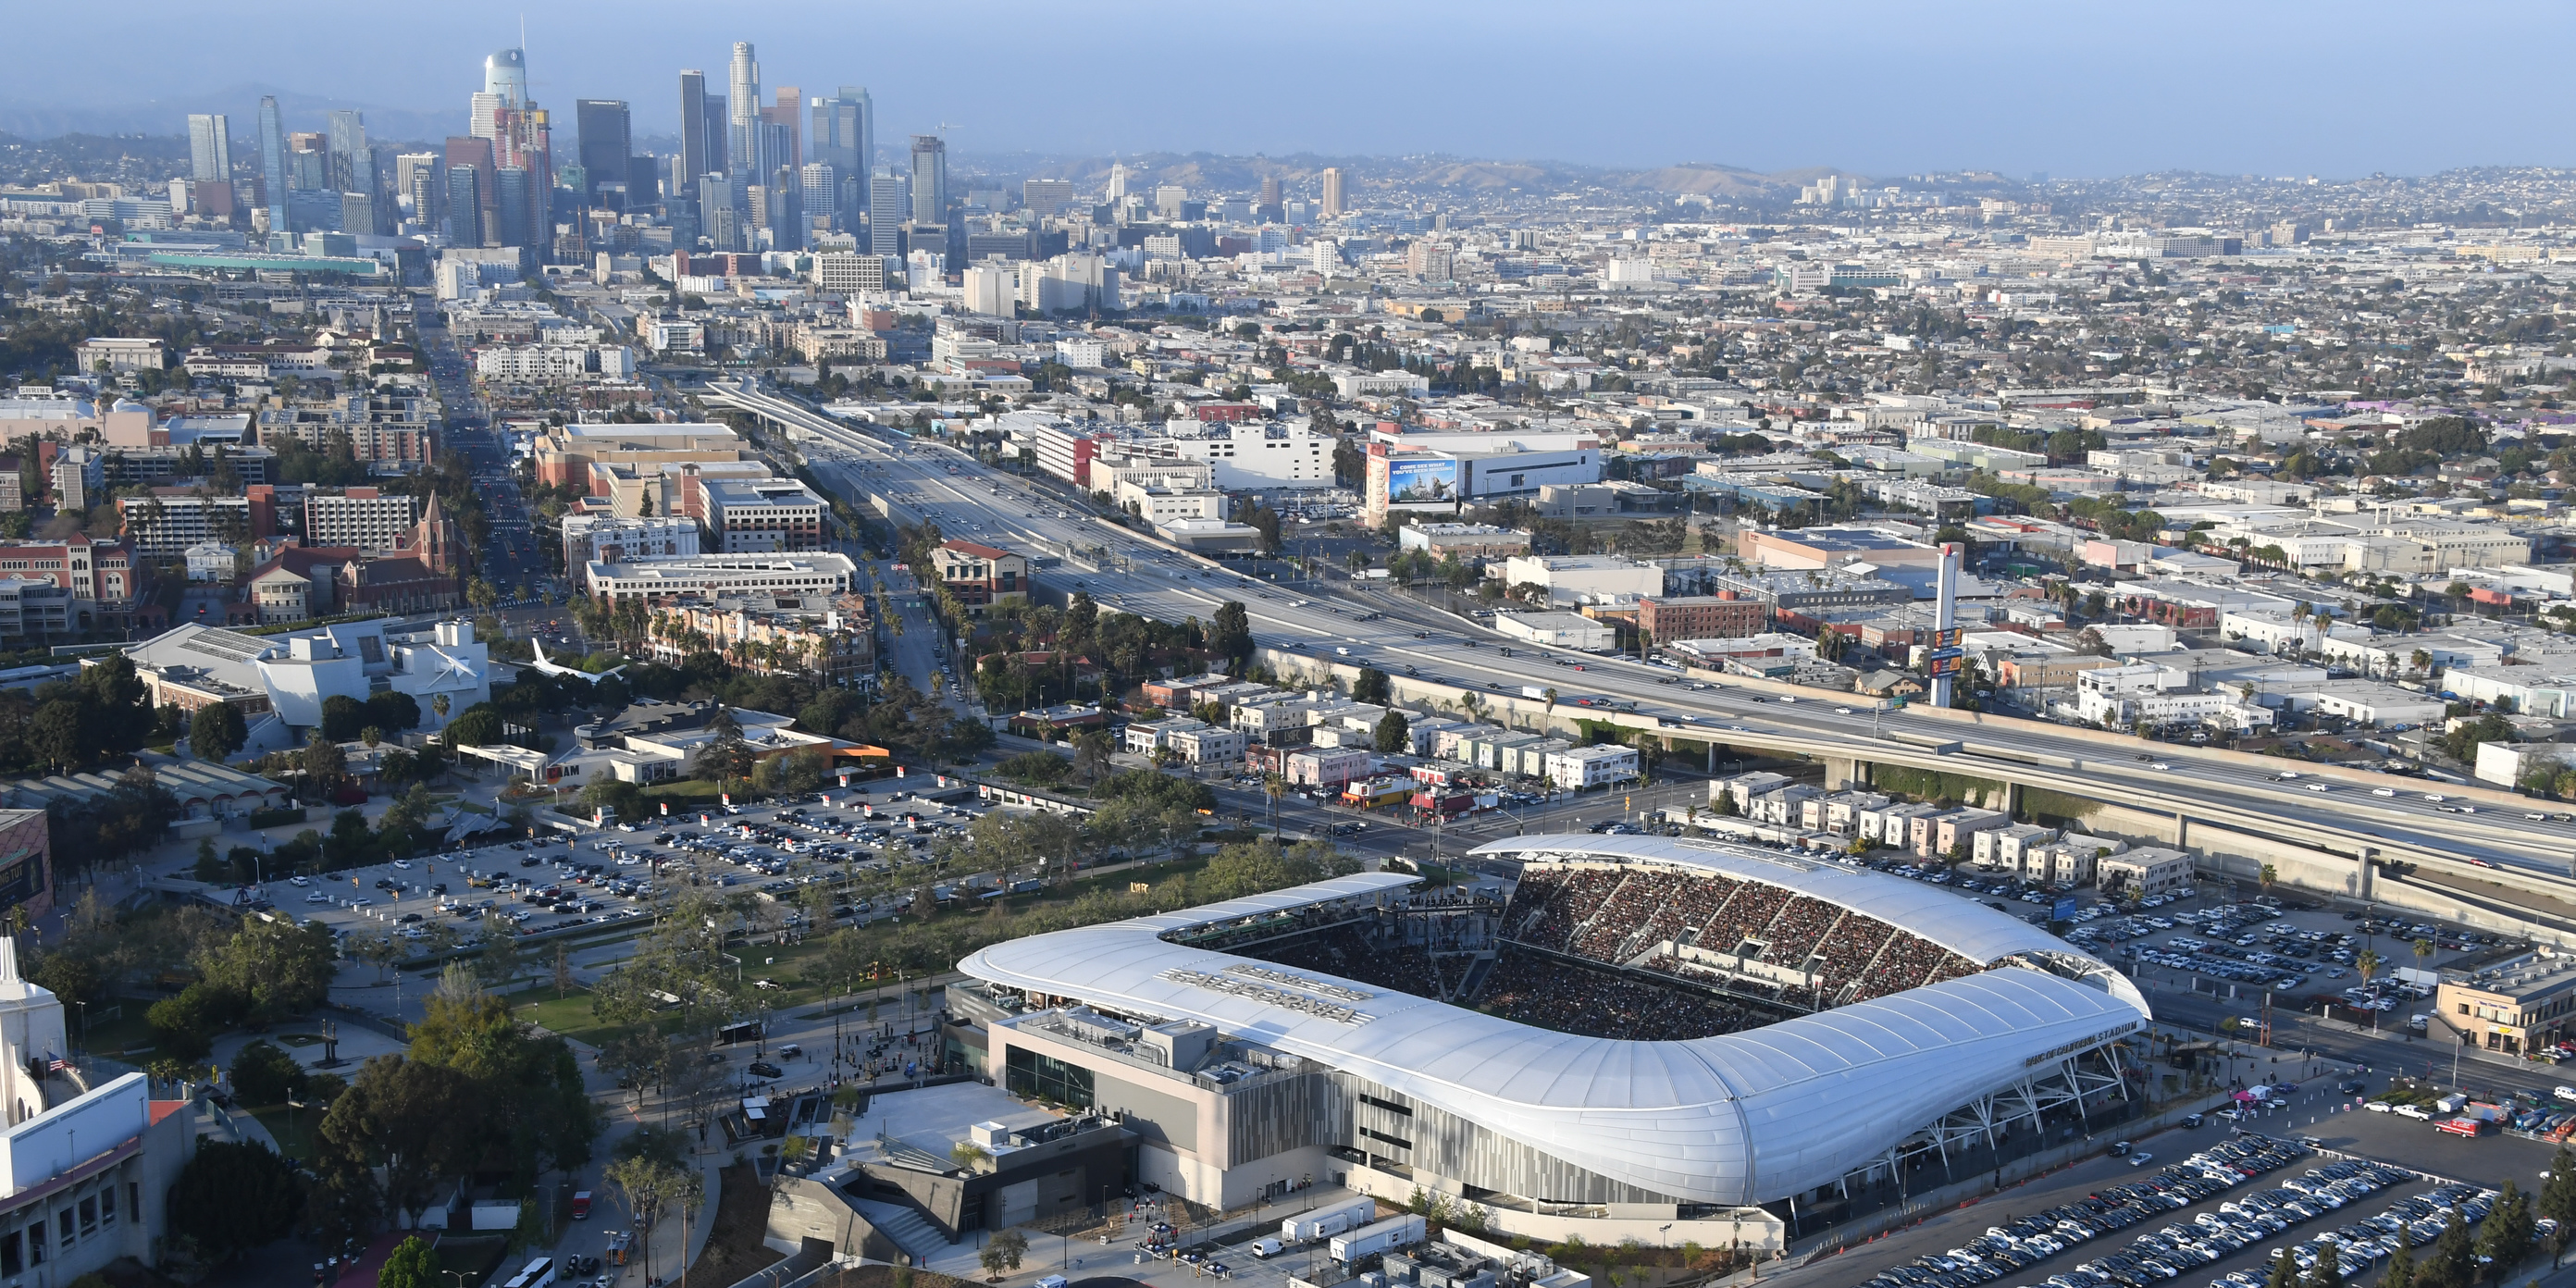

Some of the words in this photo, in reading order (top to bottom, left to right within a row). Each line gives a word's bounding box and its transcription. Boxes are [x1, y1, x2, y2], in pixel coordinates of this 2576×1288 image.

[548, 764, 580, 779] CAAM
[10, 864, 23, 880] TUT
[1168, 970, 1356, 1023] CALIFORNIA
[1221, 963, 1319, 987] BANC
[1319, 985, 1374, 1001] OF
[2025, 1053, 2046, 1068] BANC
[2045, 1048, 2057, 1060] OF
[2056, 1035, 2097, 1057] CALIFORNIA
[2098, 1021, 2137, 1042] STADIUM
